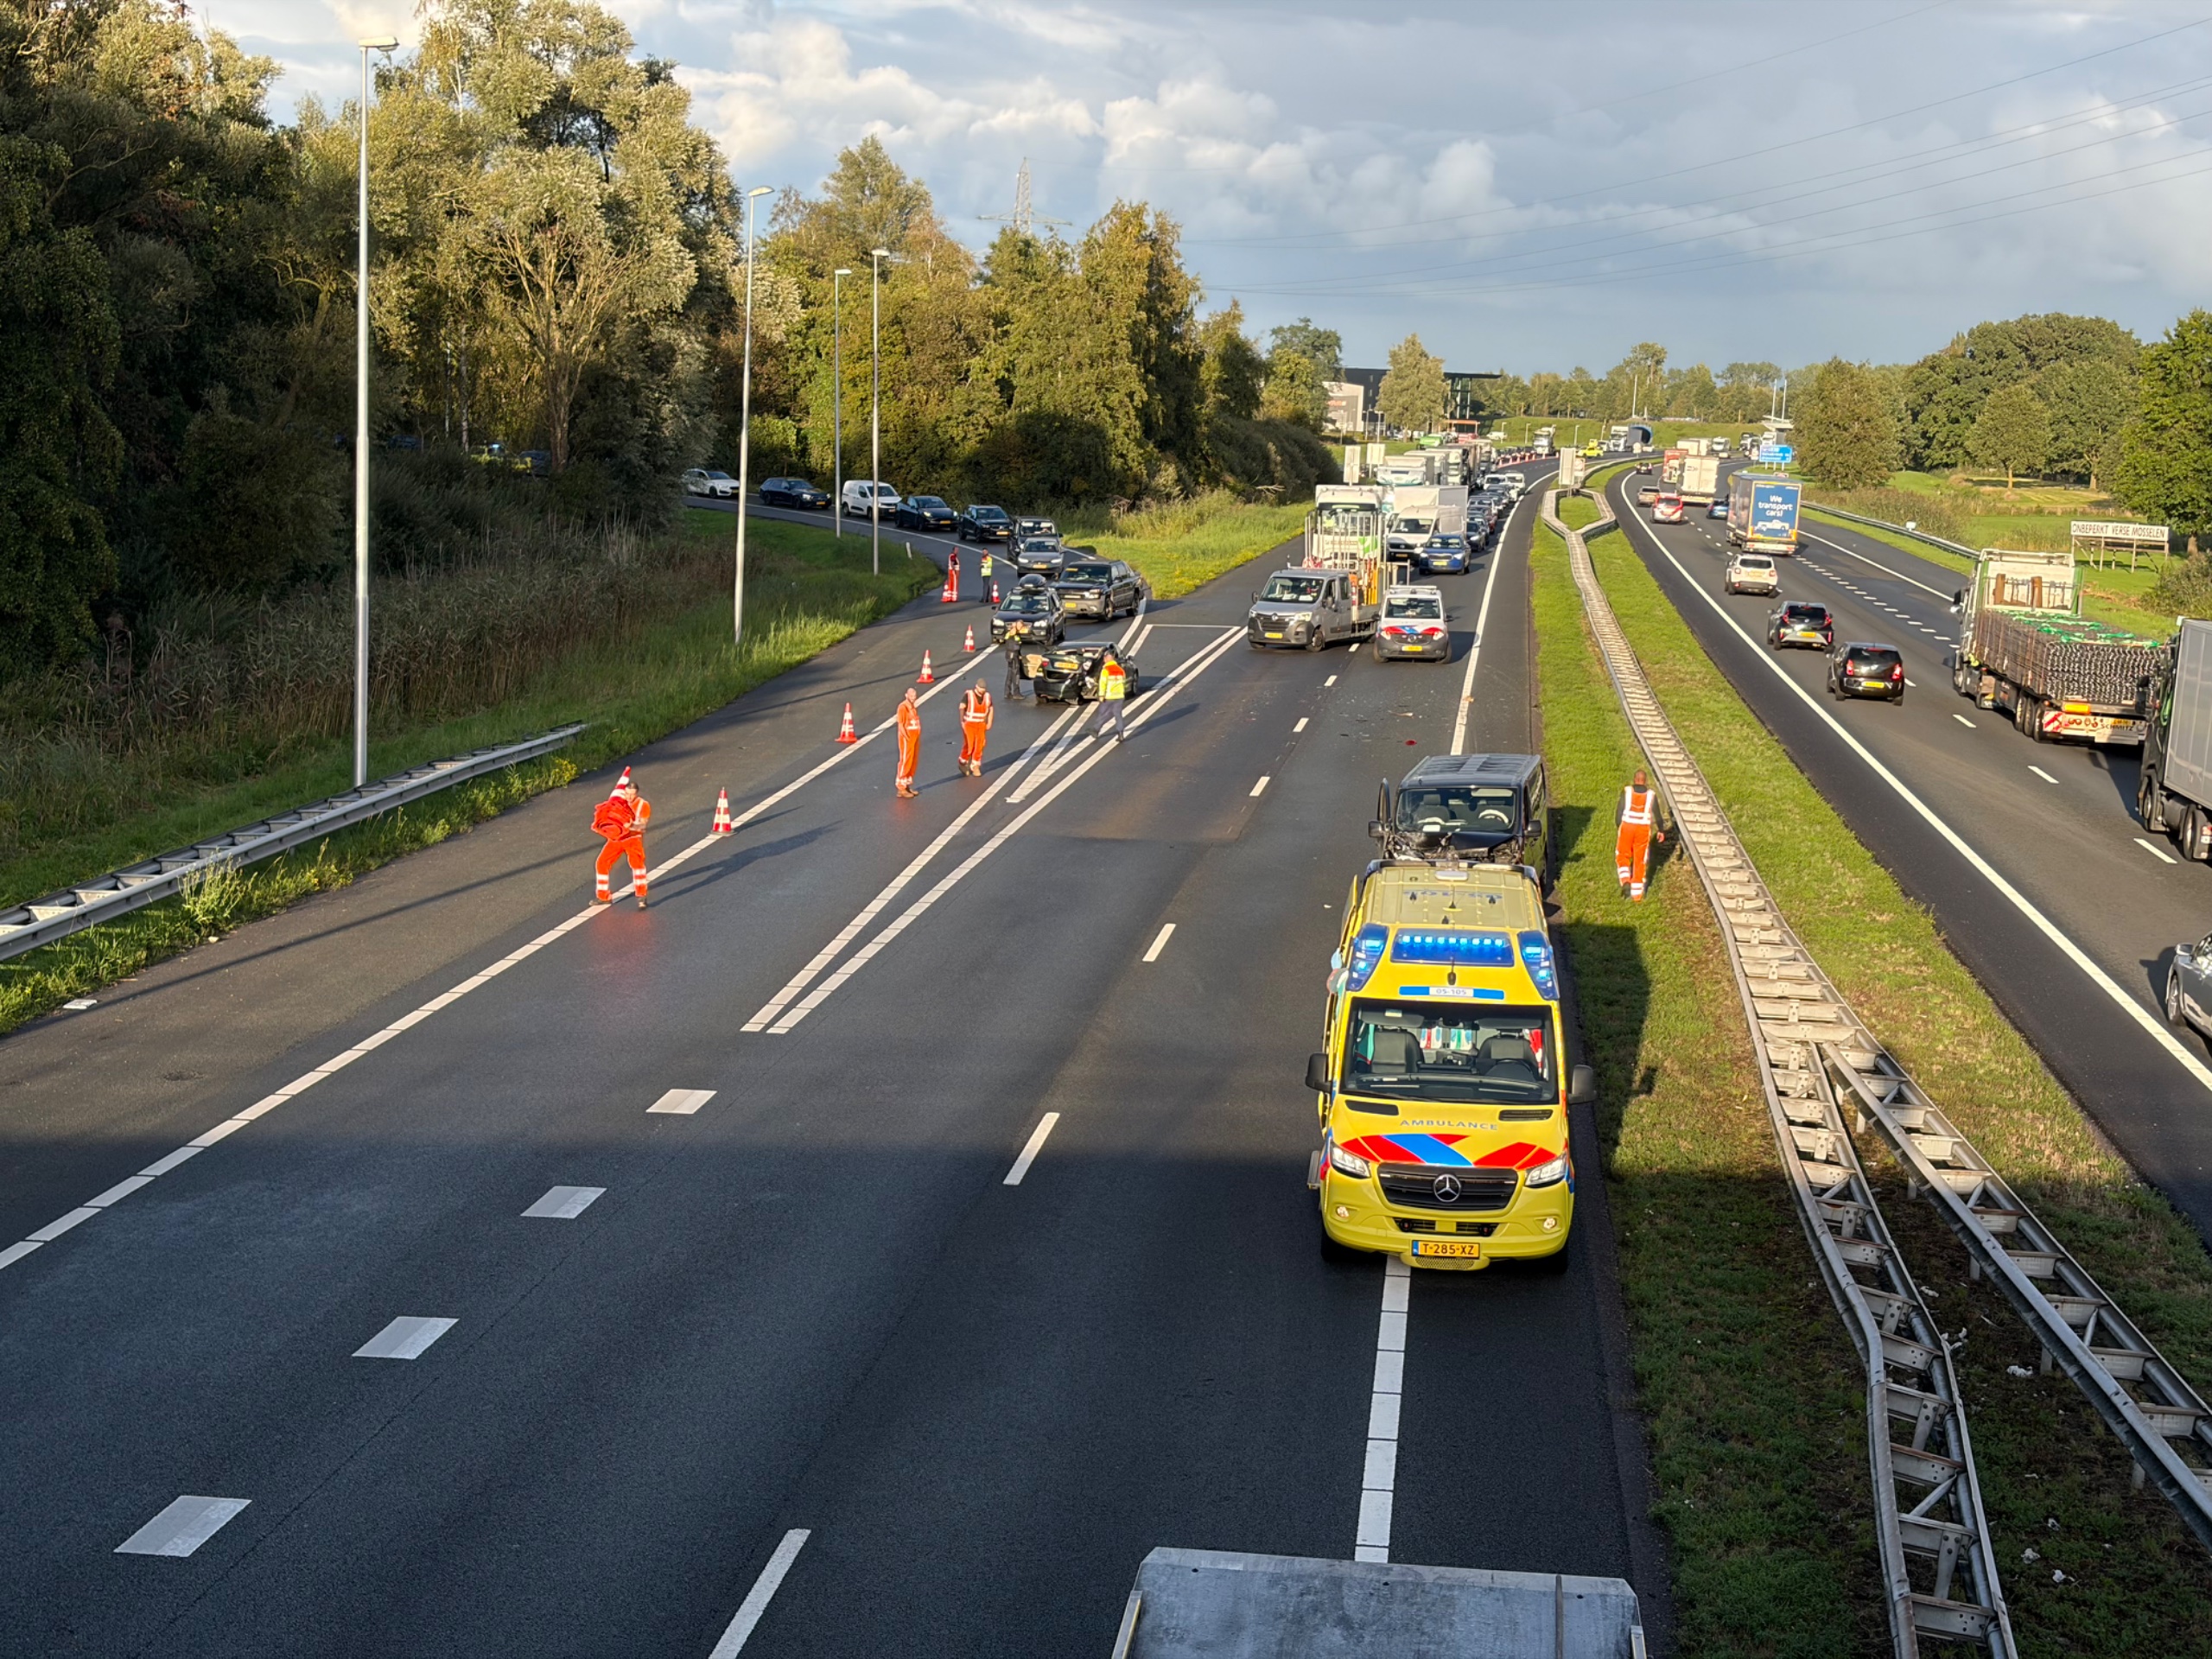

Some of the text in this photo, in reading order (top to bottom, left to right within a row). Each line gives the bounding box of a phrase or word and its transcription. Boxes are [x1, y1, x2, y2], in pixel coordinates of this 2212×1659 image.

[1758, 502, 1793, 511] transport
[2072, 524, 2165, 538] ONBEPERKT VERSE MOSSELEN
[1400, 1120, 1498, 1131] AMBULANCE
[1422, 1243, 1475, 1255] T-285-XZ
